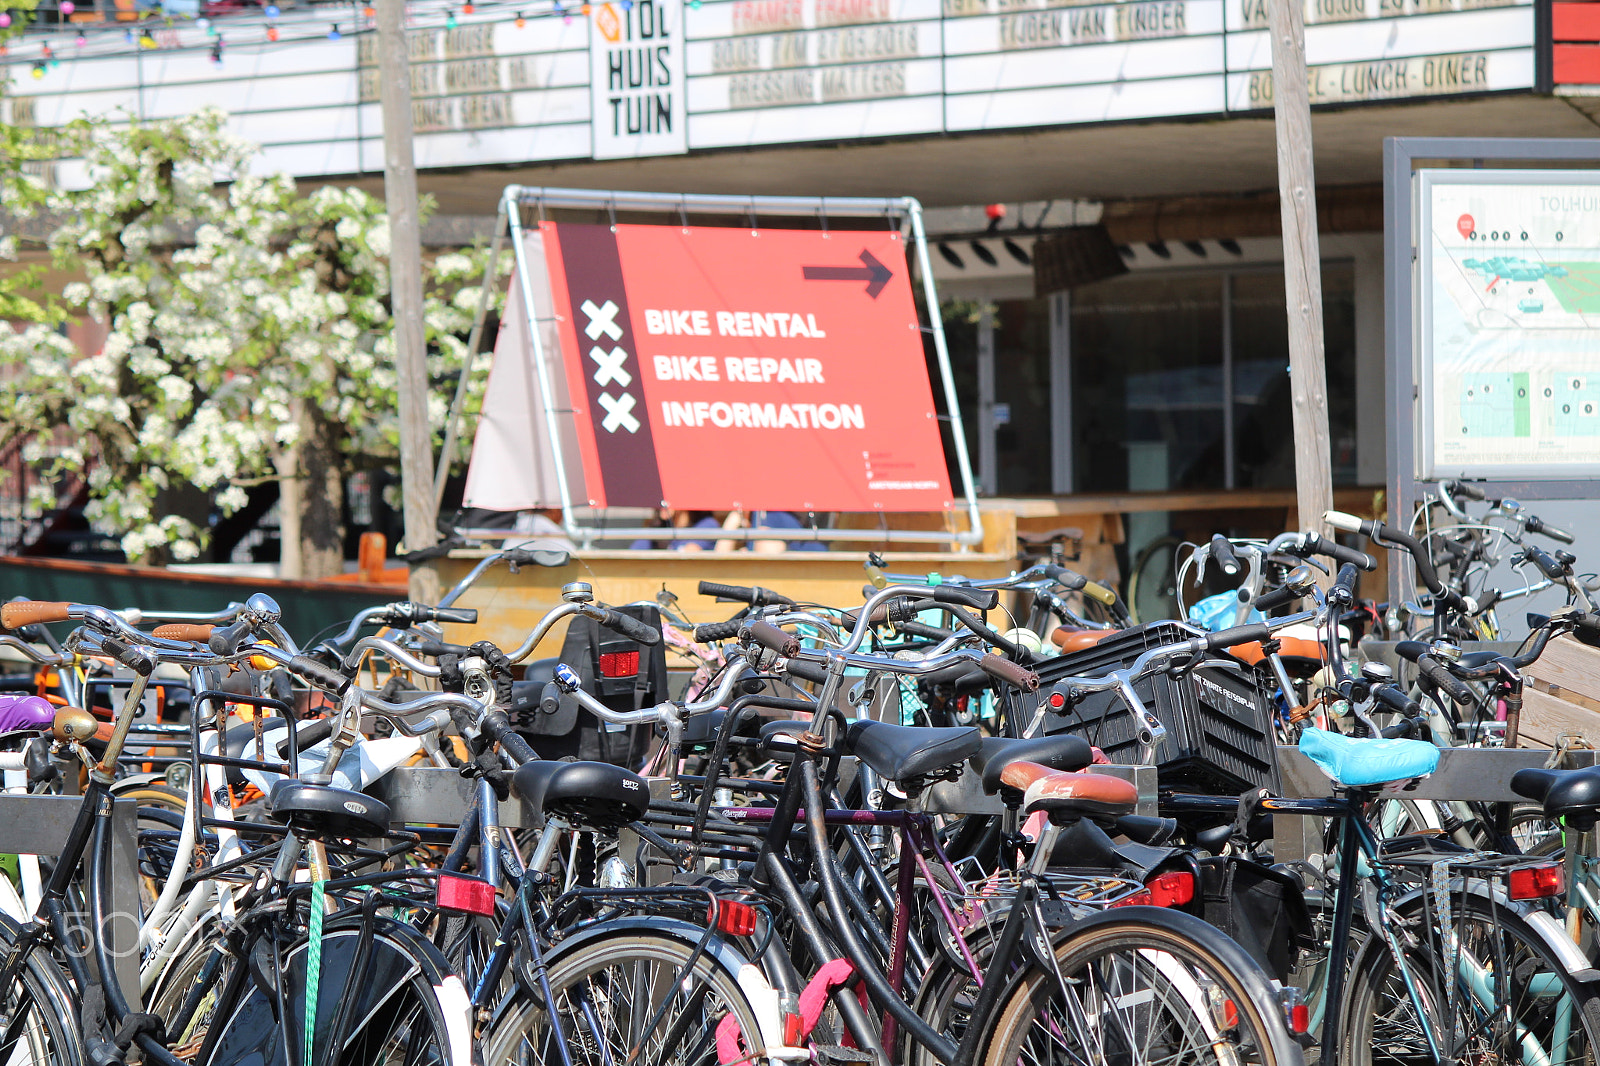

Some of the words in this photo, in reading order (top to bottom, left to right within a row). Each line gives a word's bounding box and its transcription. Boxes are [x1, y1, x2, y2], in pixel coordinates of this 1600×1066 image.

[624, 1, 669, 41] TOL
[999, 12, 1062, 44] TIJDEN
[1069, 8, 1107, 38] VAN
[1114, 2, 1187, 34] TINDER
[608, 46, 671, 90] HUIS
[729, 70, 813, 102] PRESSING
[822, 64, 906, 96] MATTERS
[413, 100, 454, 128] ONEY
[609, 94, 672, 136] TUIN
[1540, 196, 1600, 212] TOLHUI
[645, 308, 711, 336] BIKE
[716, 311, 827, 339] RENTAL
[653, 355, 719, 382] BIKE
[725, 357, 825, 384] REPAIR
[661, 401, 866, 430] INFORMATION
